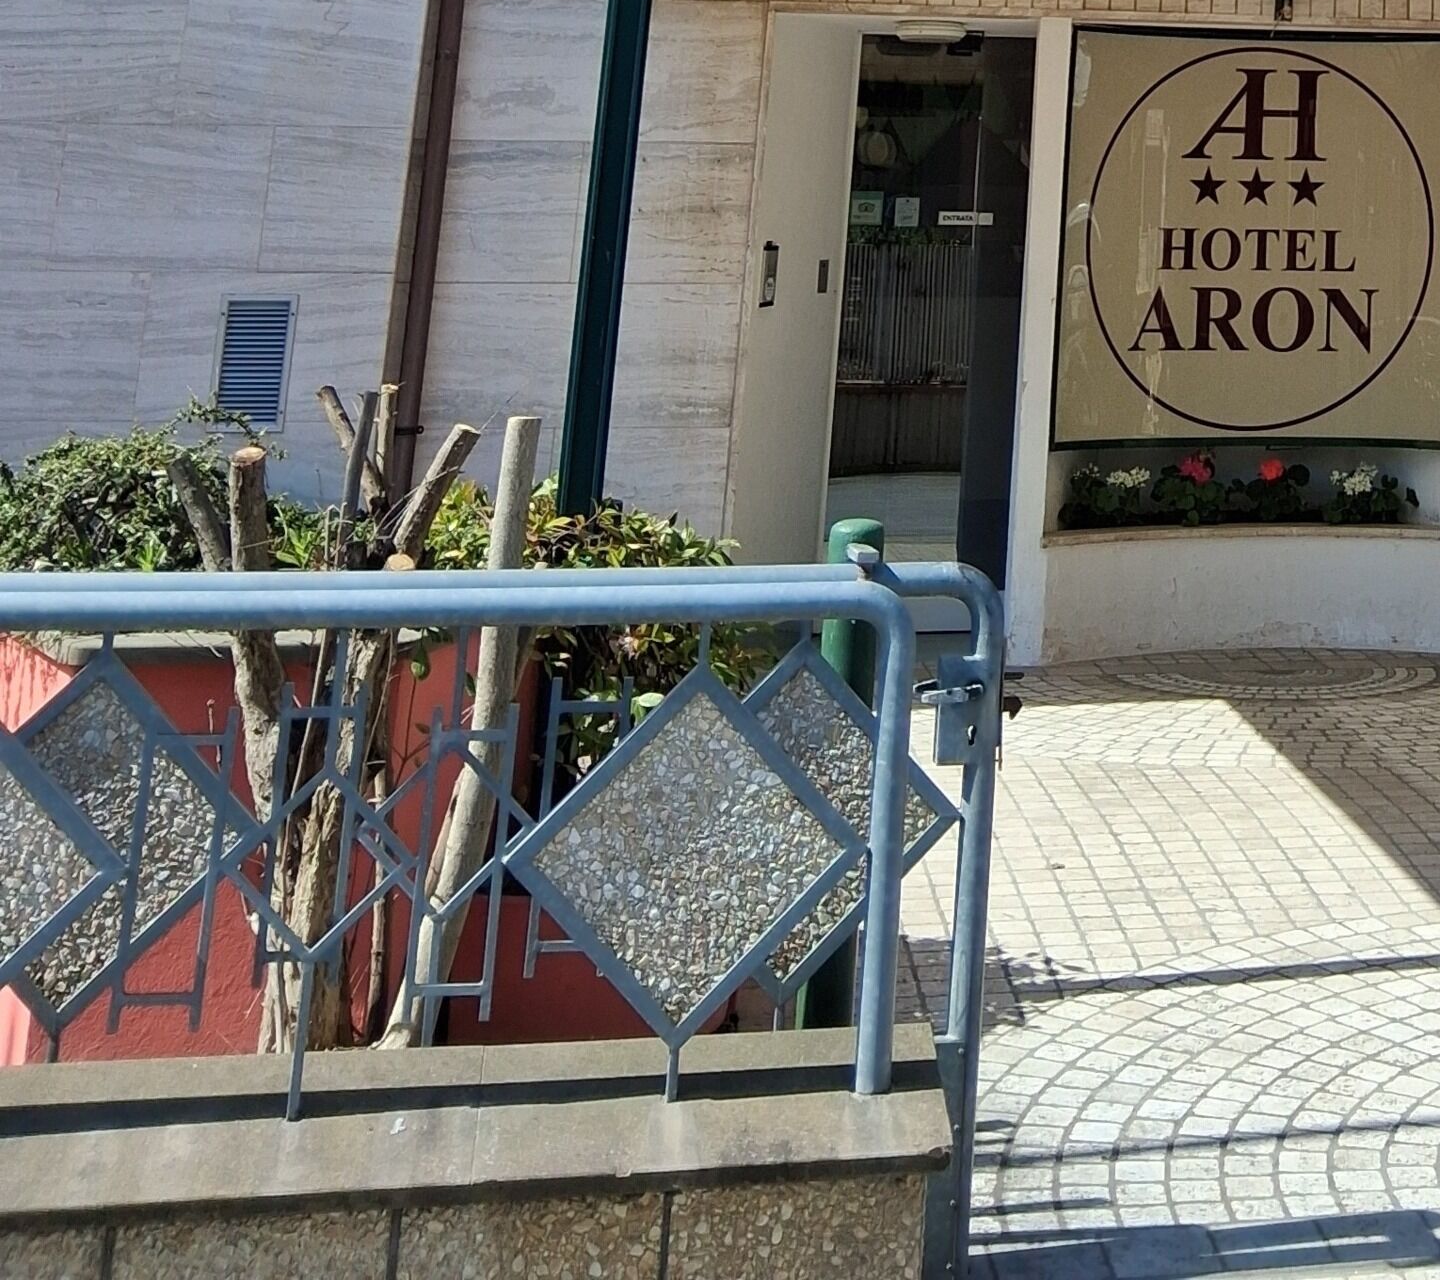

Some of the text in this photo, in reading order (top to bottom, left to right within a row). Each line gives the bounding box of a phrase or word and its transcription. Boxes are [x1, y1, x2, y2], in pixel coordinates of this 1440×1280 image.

[1181, 68, 1331, 161] AH
[1158, 228, 1357, 272] HOTEL
[1128, 286, 1379, 354] ARON
